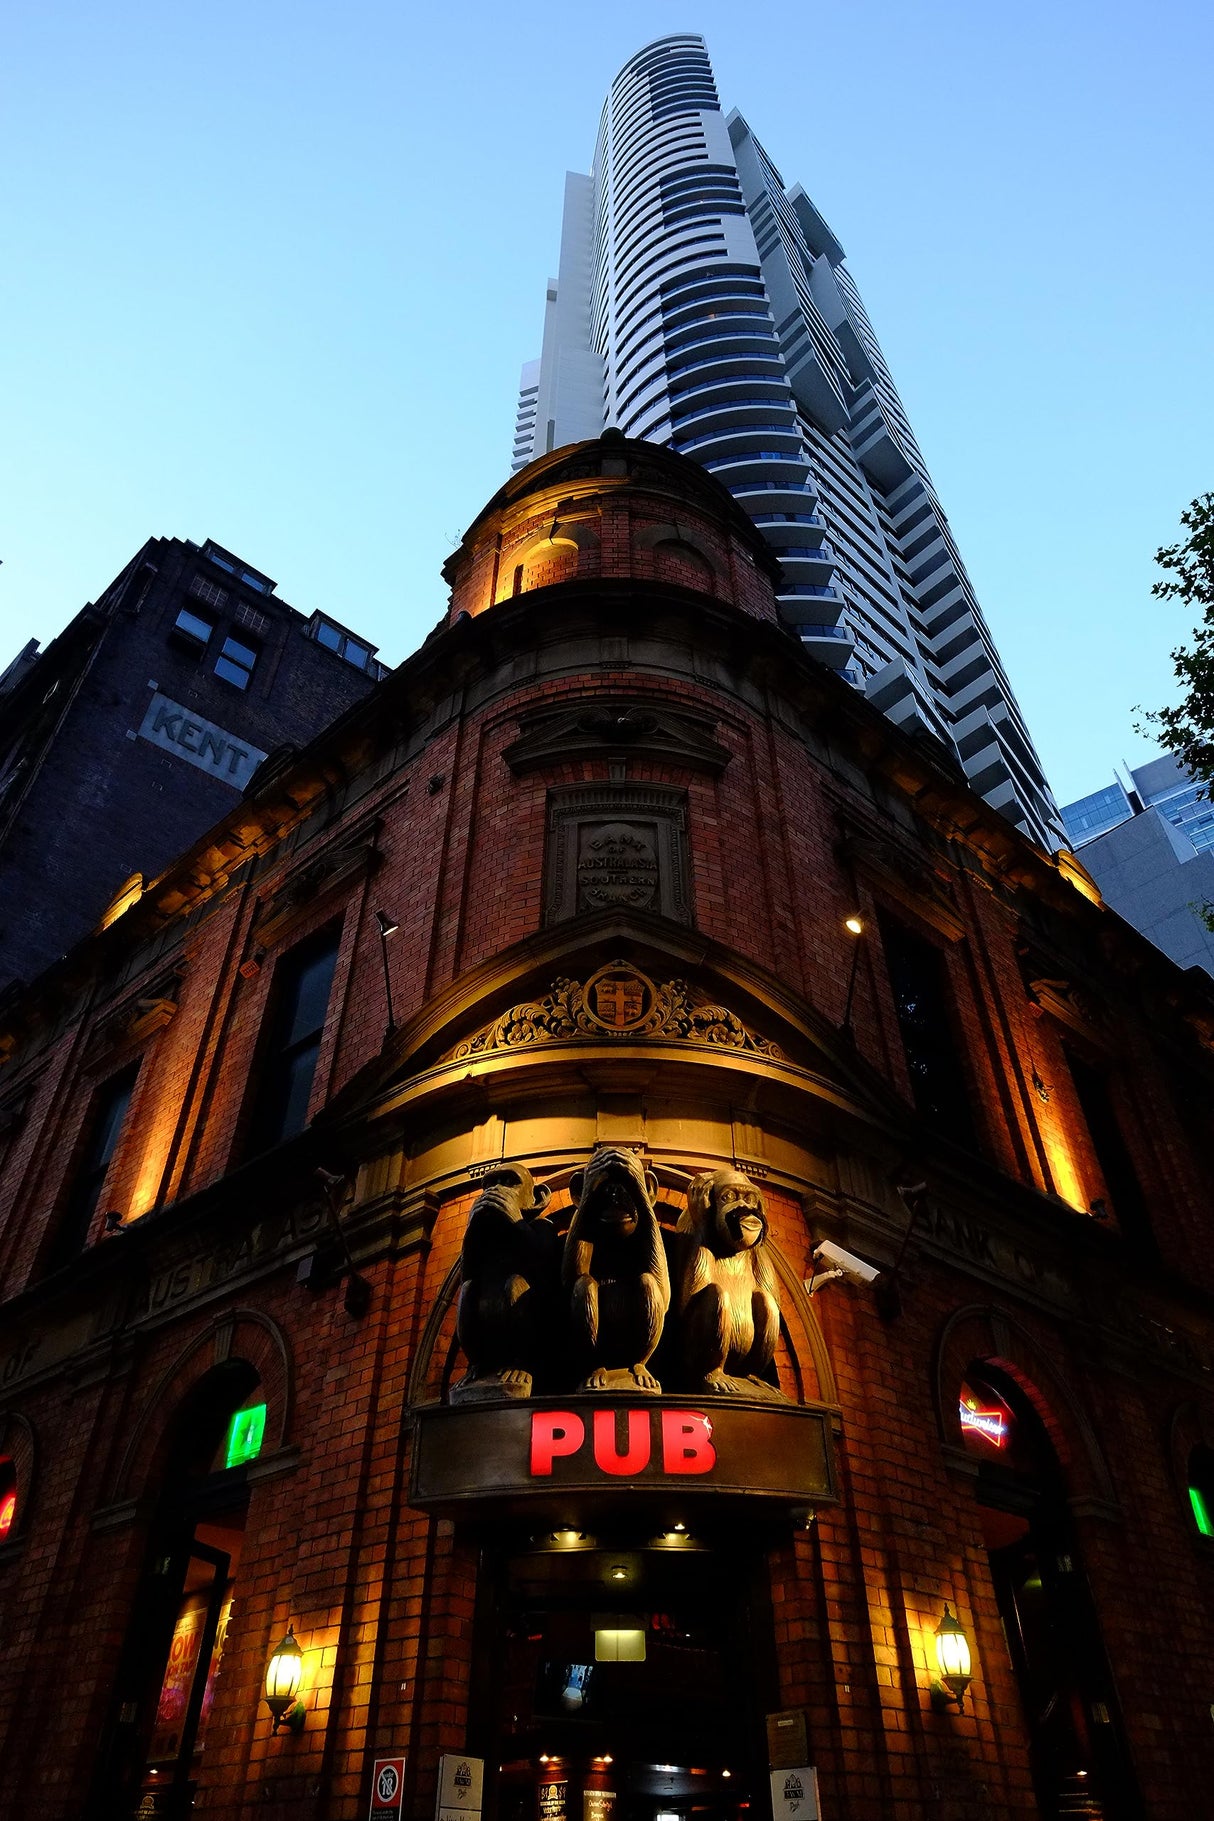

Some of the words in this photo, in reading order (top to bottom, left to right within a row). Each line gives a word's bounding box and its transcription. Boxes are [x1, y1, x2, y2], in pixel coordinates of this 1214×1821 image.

[151, 706, 249, 774] KENT
[589, 833, 648, 852] BANK
[577, 857, 658, 871] AUSTRALASIA
[579, 875, 656, 887] SOUTHERN
[530, 1408, 718, 1477] PUB
